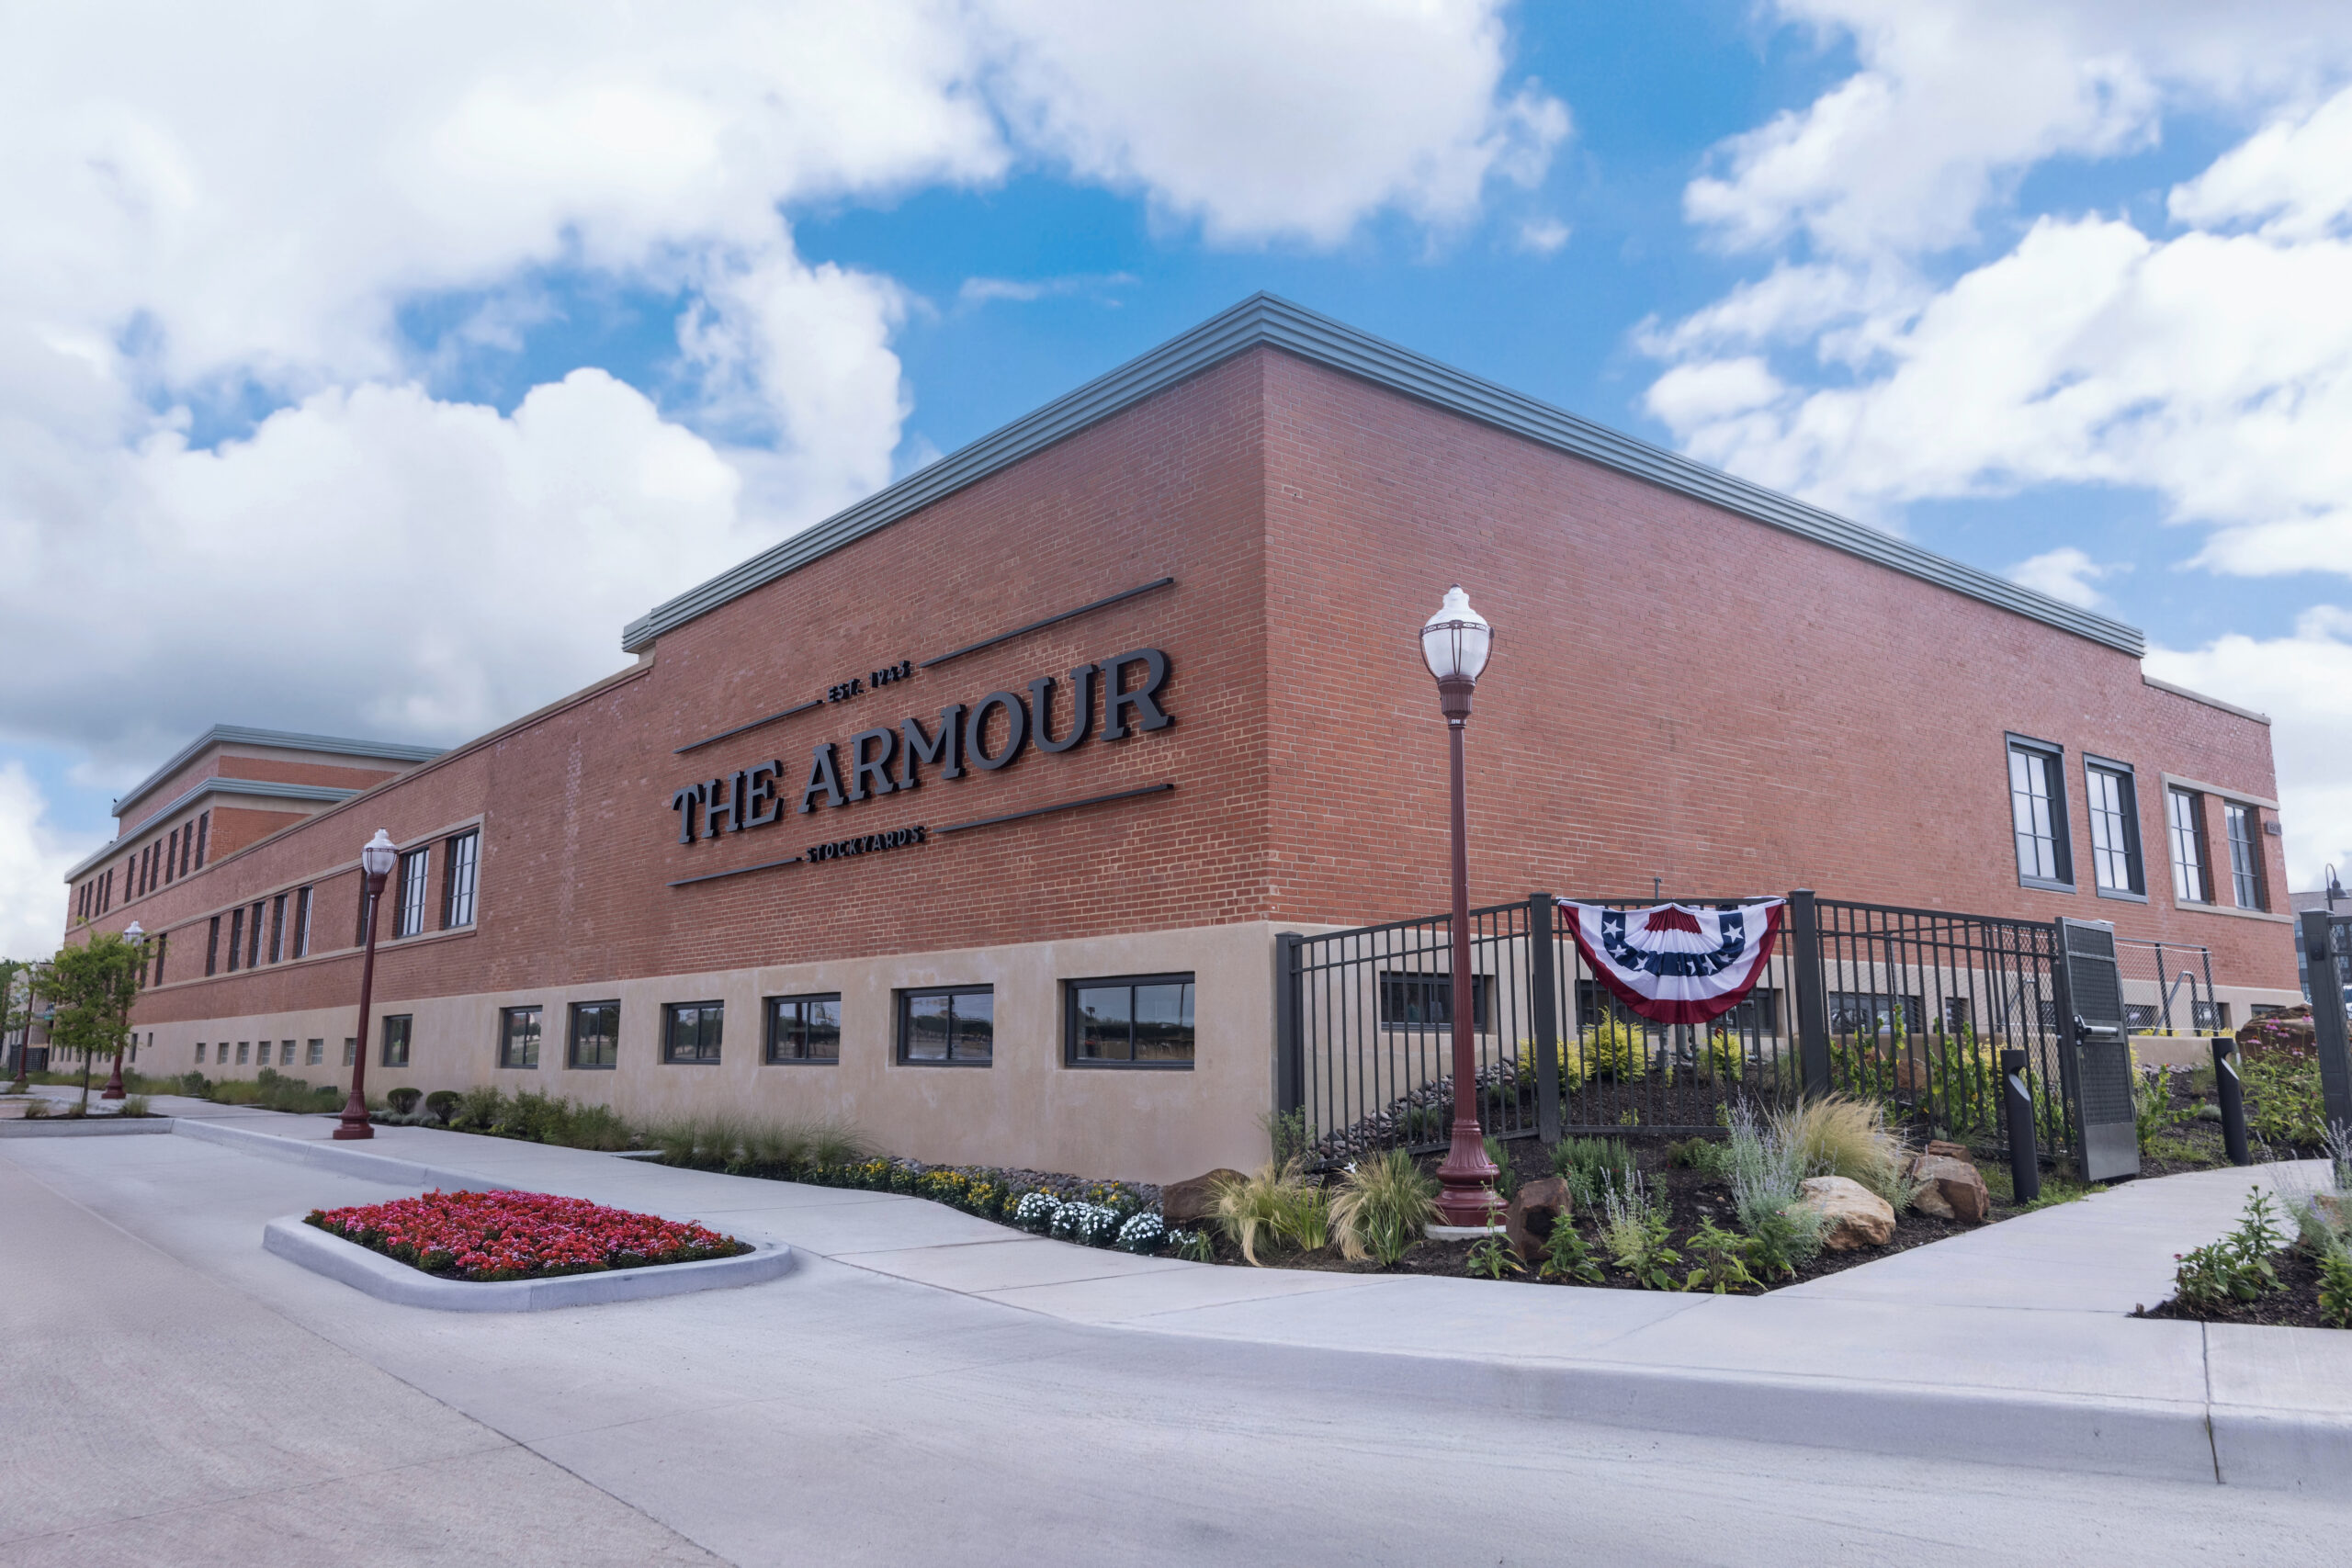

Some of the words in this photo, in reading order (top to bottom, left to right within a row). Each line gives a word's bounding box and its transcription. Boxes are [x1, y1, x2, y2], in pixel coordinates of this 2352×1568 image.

[828, 679, 865, 703] EST.
[868, 660, 910, 688] 1943
[673, 760, 785, 844] THE
[797, 648, 1174, 813] ARMOUR
[806, 826, 925, 863] STOCKYARDS
